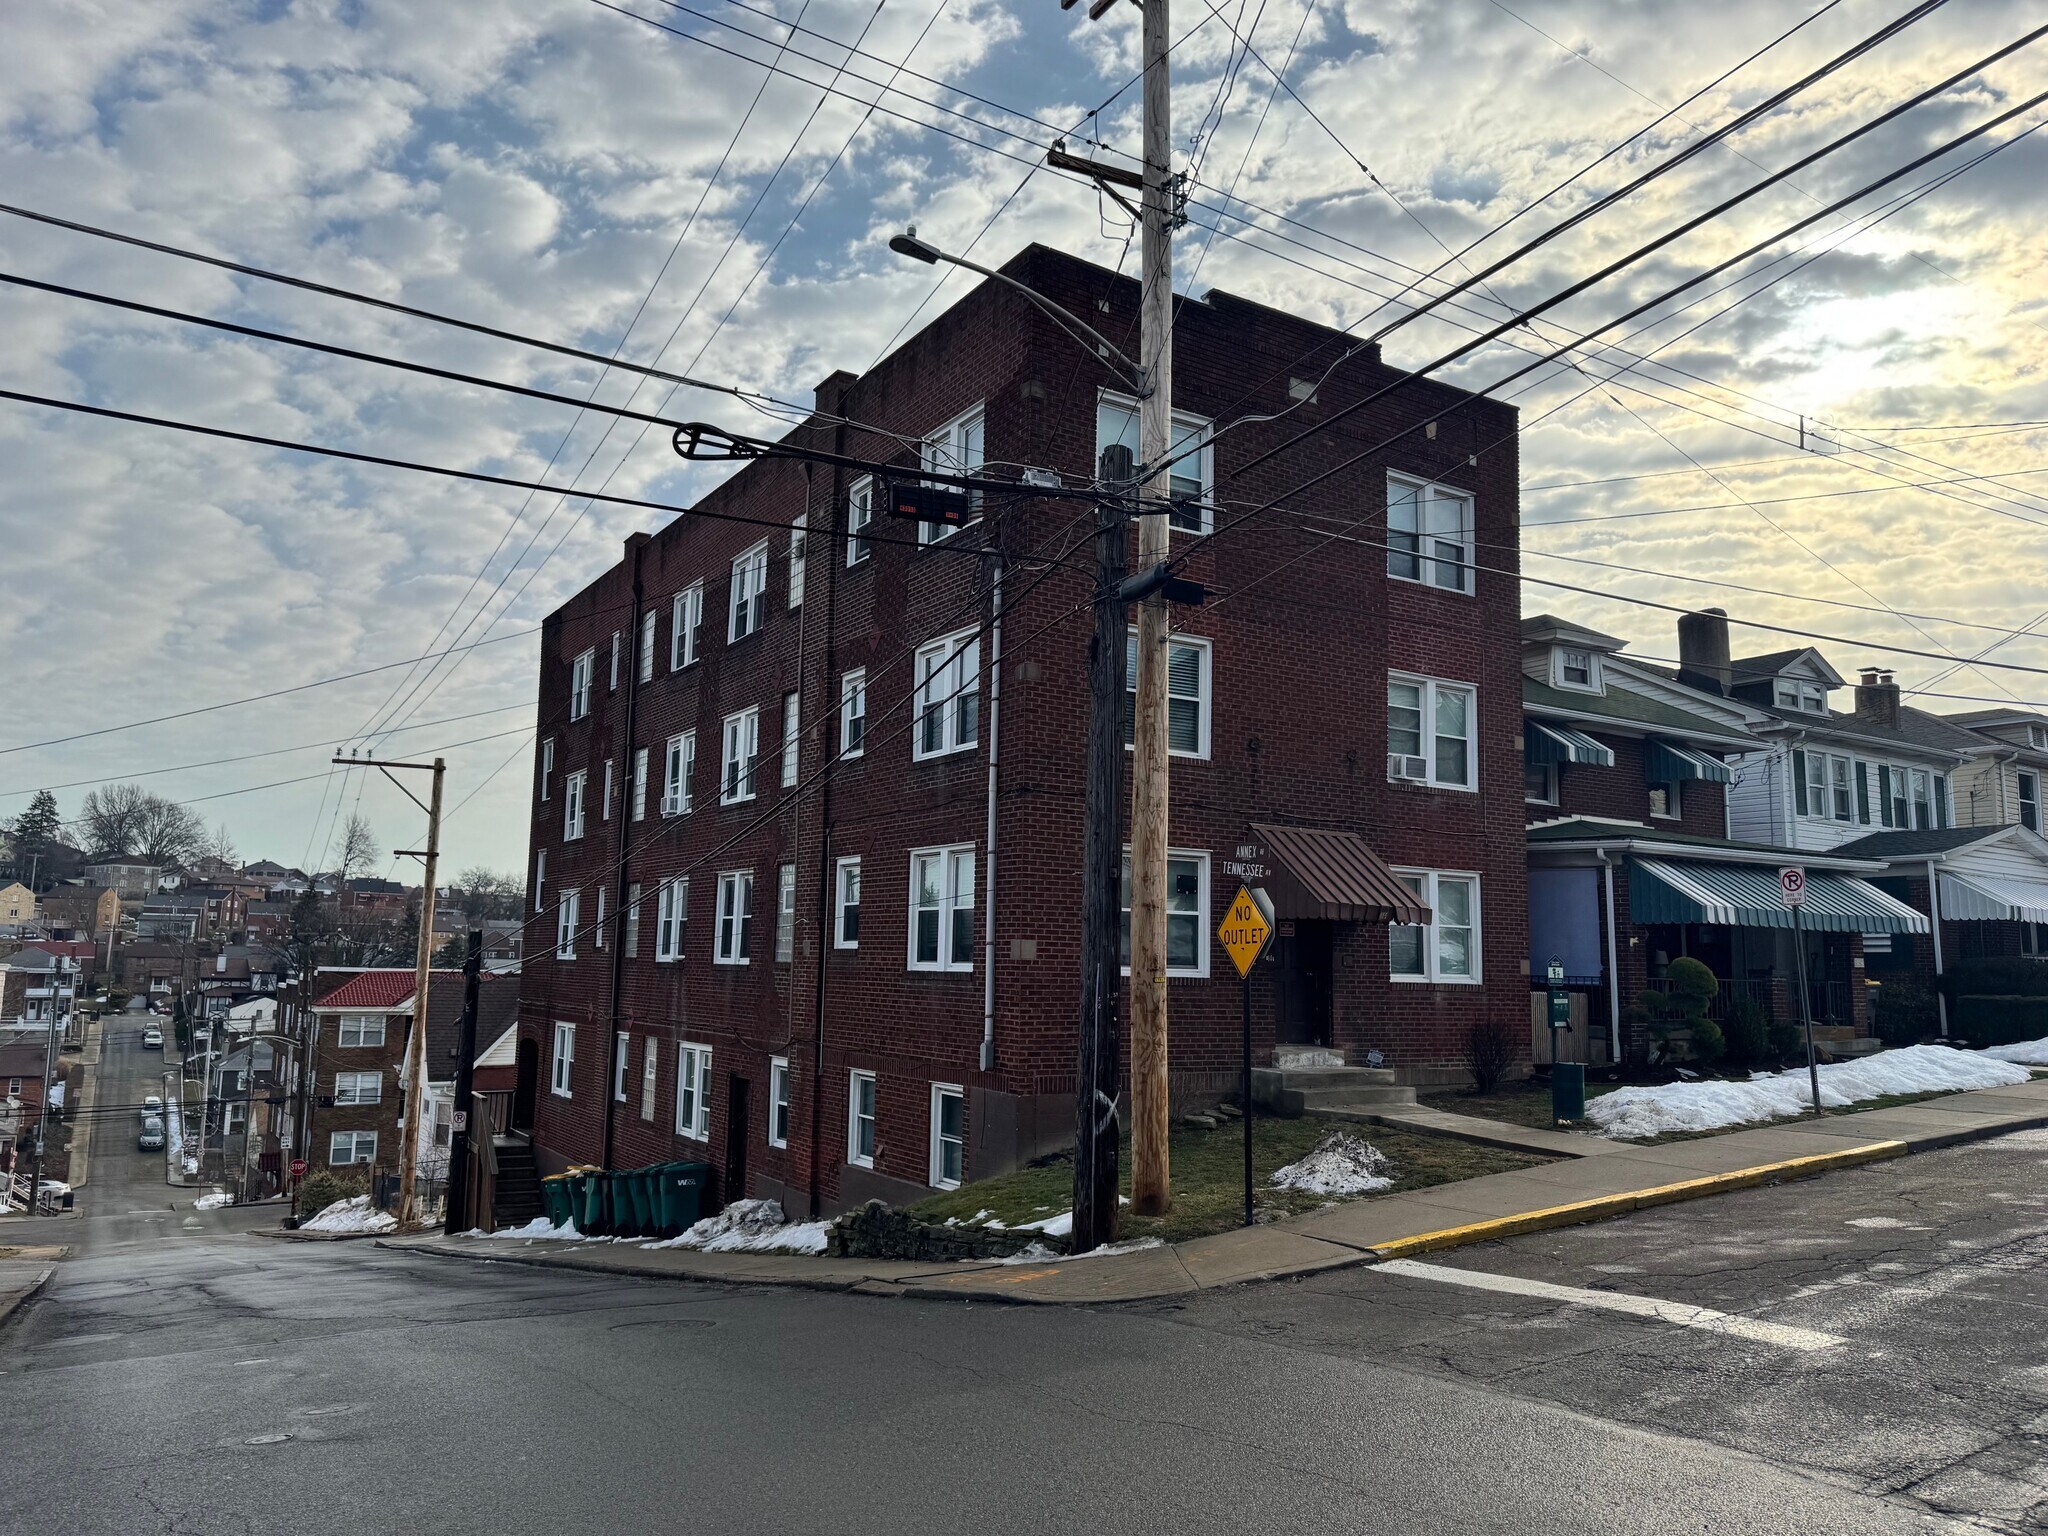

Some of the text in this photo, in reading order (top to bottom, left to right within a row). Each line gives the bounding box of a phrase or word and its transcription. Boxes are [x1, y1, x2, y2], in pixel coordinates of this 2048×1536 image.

[1235, 845, 1257, 858] ANNEX
[1222, 862, 1264, 877] TENNESSEE
[1235, 905, 1251, 921] NO
[1223, 928, 1264, 945] OUTLET
